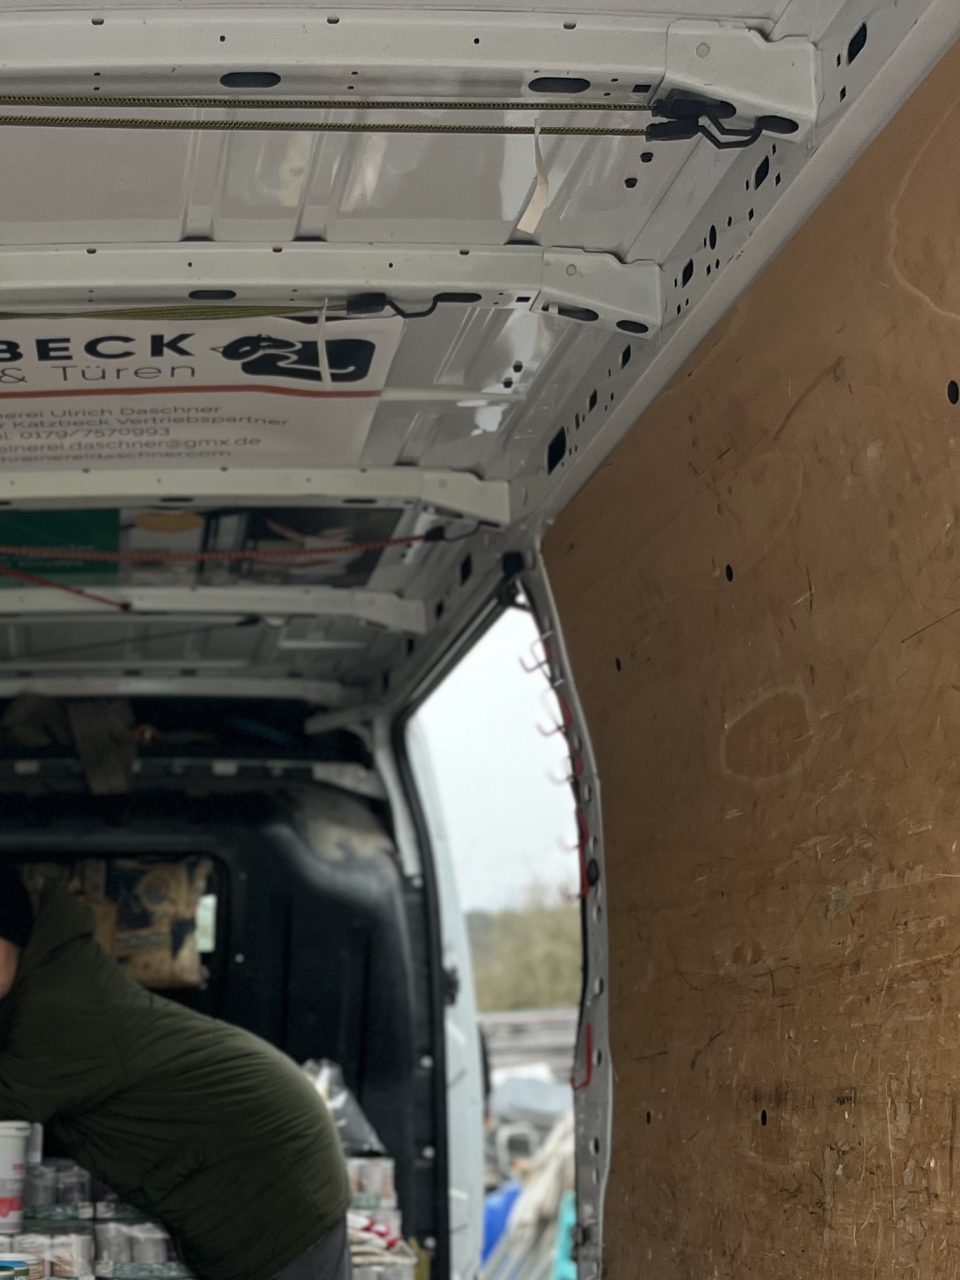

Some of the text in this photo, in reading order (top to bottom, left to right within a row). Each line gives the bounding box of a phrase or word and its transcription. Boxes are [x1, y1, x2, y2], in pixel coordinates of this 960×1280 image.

[51, 365, 196, 382] Türen
[50, 407, 113, 418] Ulrich
[119, 405, 222, 416] Daschner
[13, 417, 110, 429] Katzbeck
[116, 414, 289, 427] Vertriebspartner
[19, 427, 171, 440] 0179/7570993
